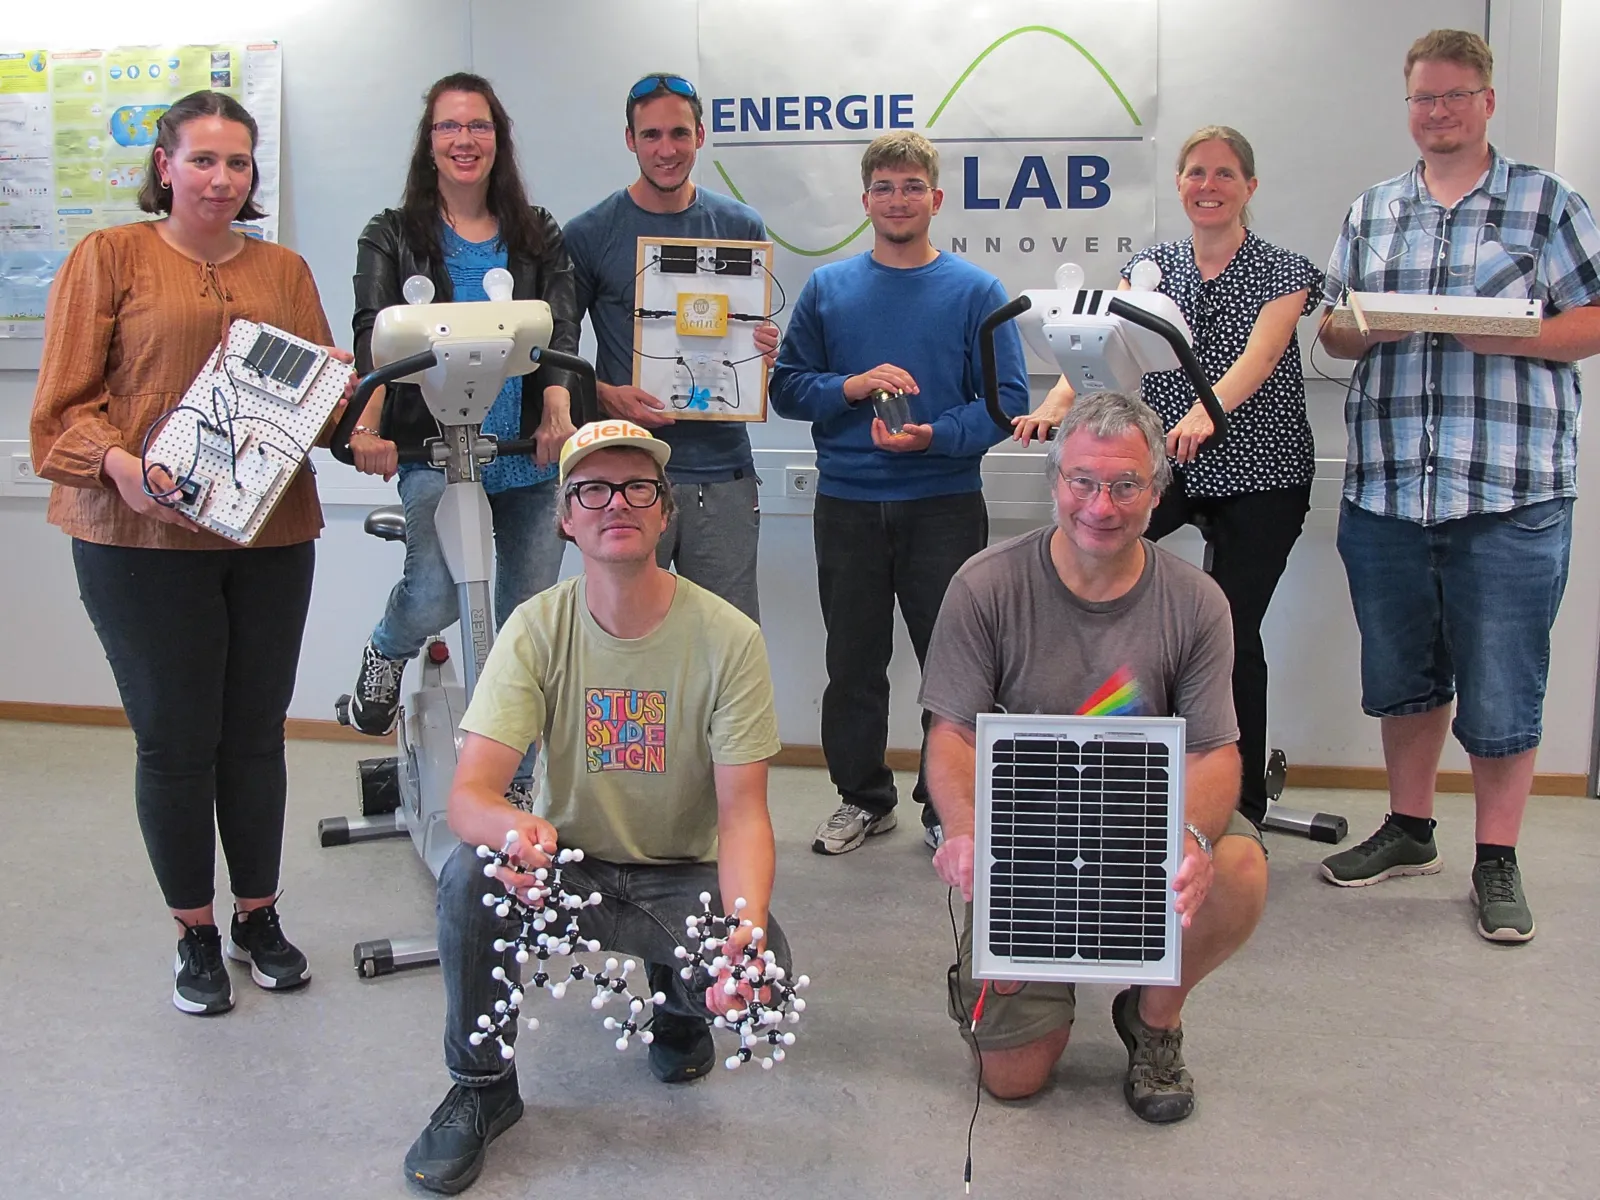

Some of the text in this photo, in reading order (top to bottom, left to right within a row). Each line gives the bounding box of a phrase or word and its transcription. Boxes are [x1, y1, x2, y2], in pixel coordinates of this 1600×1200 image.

[711, 94, 914, 132] ENERGIE
[963, 155, 1111, 210] LAB
[951, 236, 1133, 253] NNOVER
[471, 607, 488, 678] ETTLER
[587, 719, 665, 746] SYDE
[587, 743, 665, 772] SIGN
